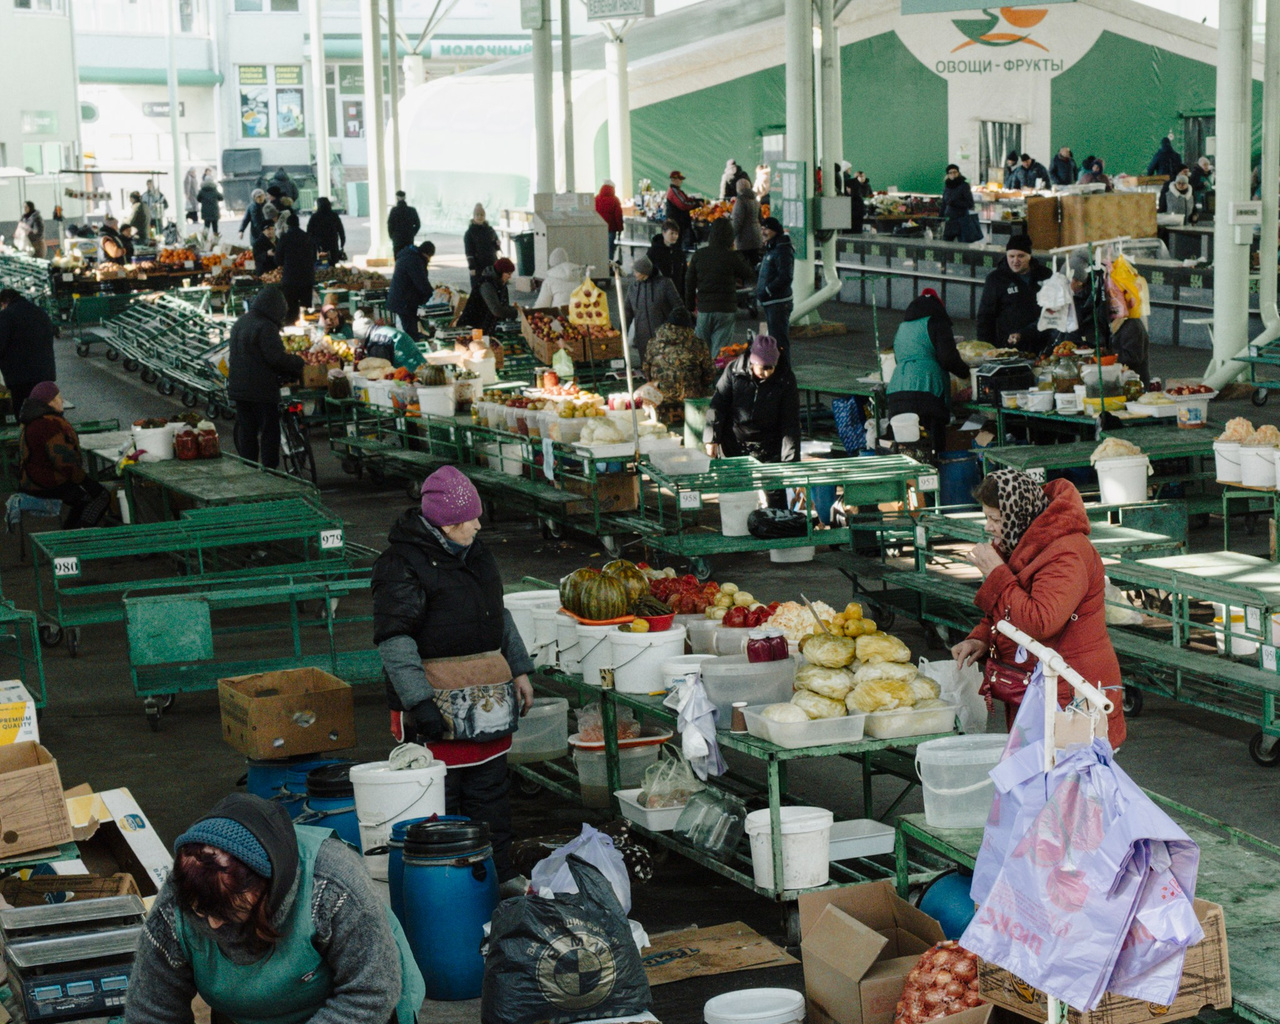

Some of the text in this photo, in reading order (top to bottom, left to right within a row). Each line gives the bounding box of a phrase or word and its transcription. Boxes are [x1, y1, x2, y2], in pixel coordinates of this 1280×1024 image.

[440, 43, 533, 57] МОЛОЧНЫЙ
[935, 60, 992, 75] ОВОЩИ
[1003, 59, 1063, 72] ФРУКТЫ
[682, 493, 698, 503] 958
[321, 532, 344, 547] 979
[54, 560, 79, 575] 980
[2, 722, 32, 730] QUALITY
